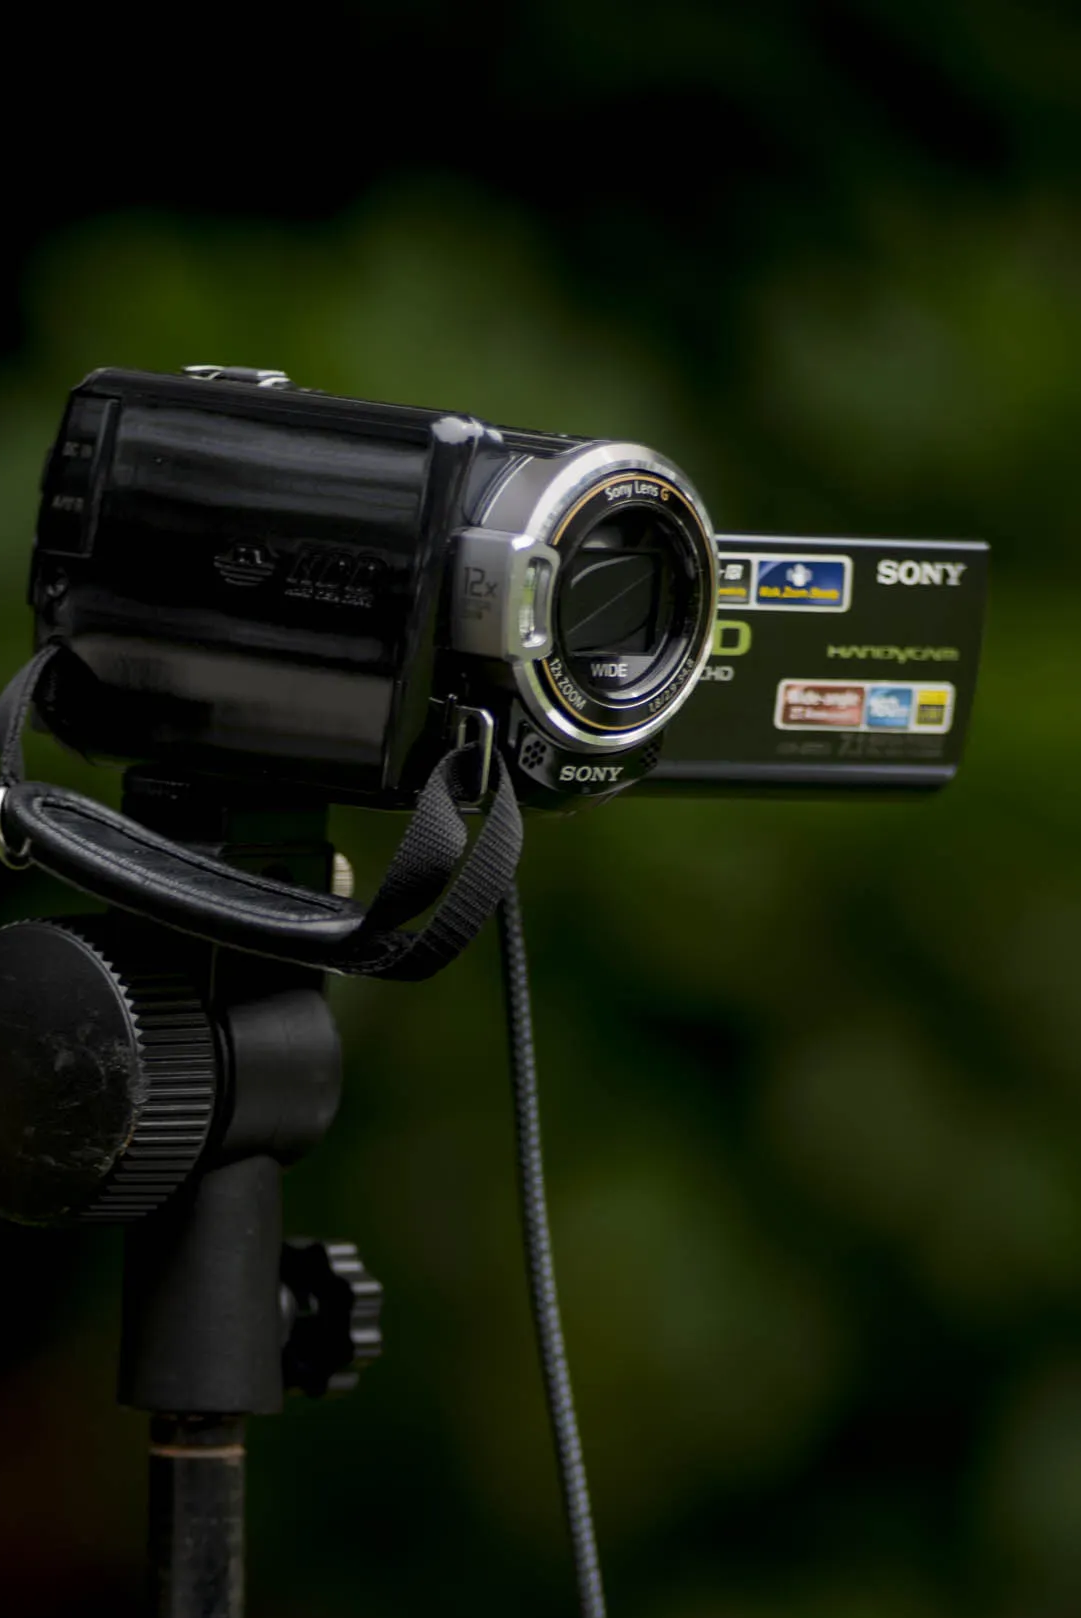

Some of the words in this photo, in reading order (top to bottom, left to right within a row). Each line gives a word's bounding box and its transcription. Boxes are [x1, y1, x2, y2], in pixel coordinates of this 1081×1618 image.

[604, 483, 633, 501] Sony
[634, 480, 659, 497] Lens
[463, 566, 498, 598] 12x
[876, 559, 967, 586] SONY
[826, 644, 960, 664] HANDYCAM
[590, 662, 628, 678] WIDE
[549, 657, 564, 680] 12x
[558, 676, 588, 711] ZOOM
[558, 765, 624, 782] SONY
